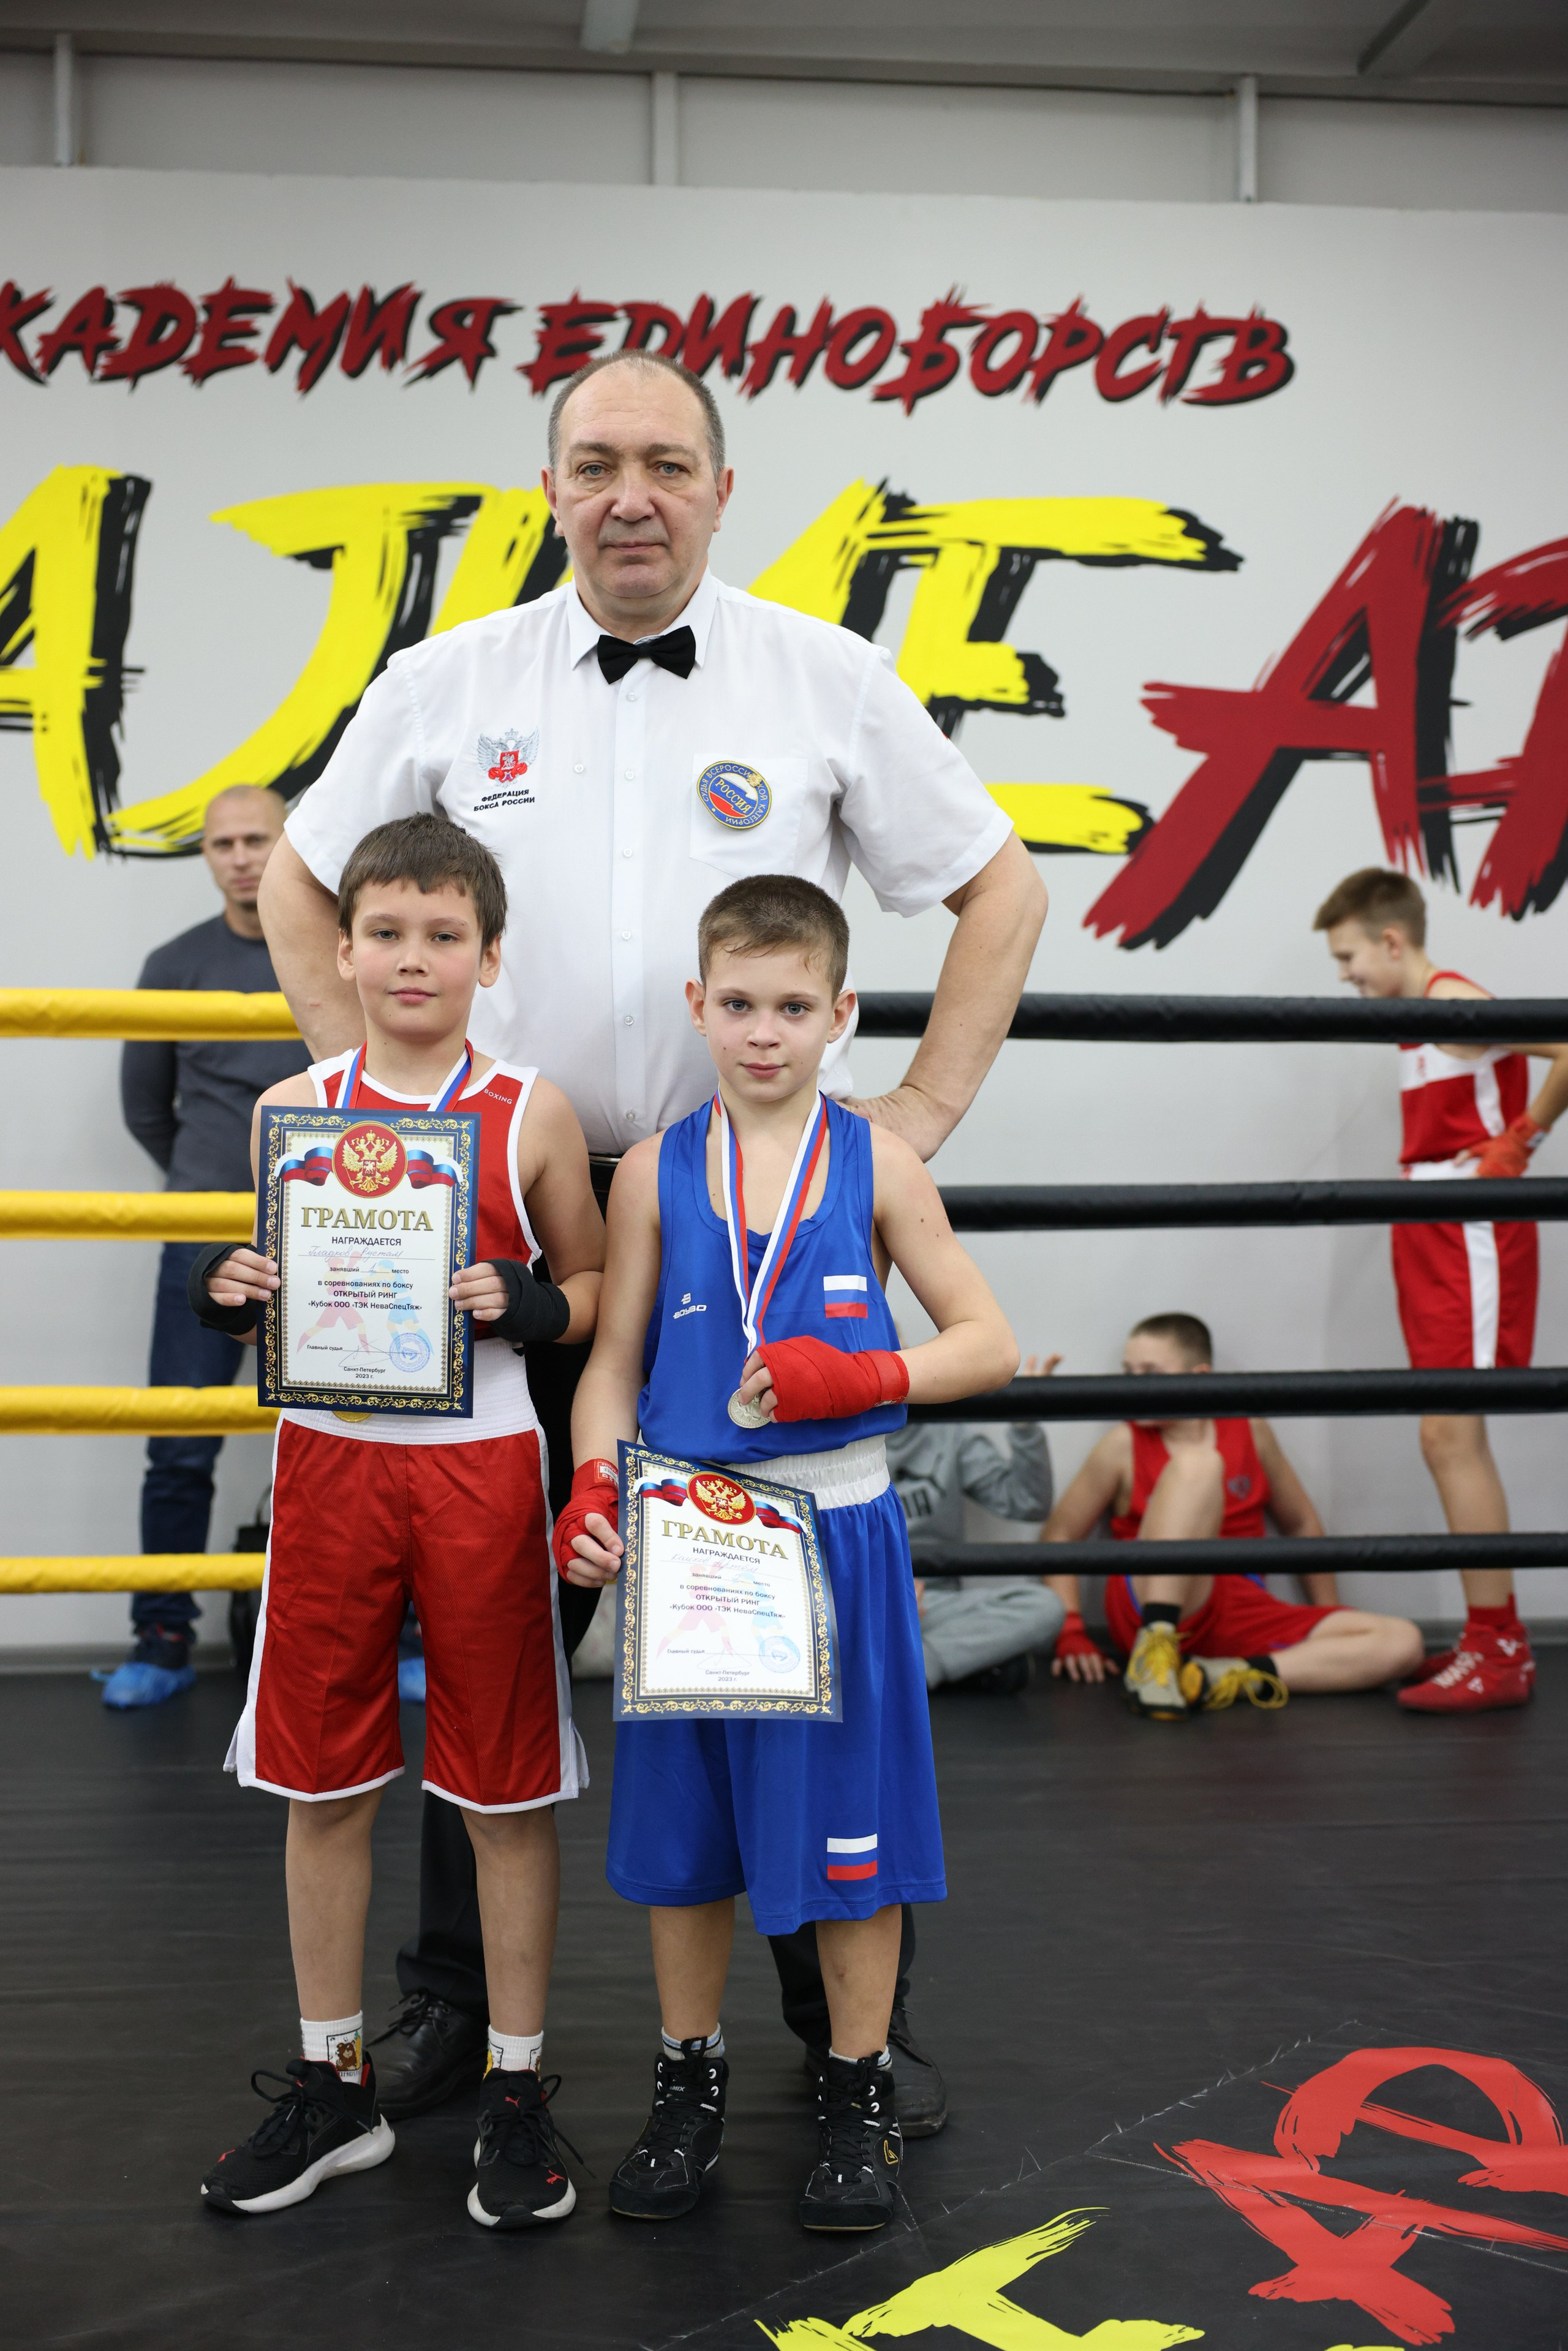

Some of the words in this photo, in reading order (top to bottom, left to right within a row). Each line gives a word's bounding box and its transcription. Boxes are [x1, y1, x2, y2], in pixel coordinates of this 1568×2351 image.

[516, 285, 1295, 417] ЕДИНОБОРСТВ
[700, 778, 709, 802] СУДЬЯ
[706, 764, 768, 801] ВСЕРОССИКОЙ
[481, 789, 529, 802] ФЕДЕРАЦИЯ
[715, 778, 752, 813] РОССИЯ
[473, 801, 499, 812] БОКСА
[502, 796, 535, 806] РОССИИ
[725, 804, 766, 825] КАТЕГОРИИ
[484, 1088, 513, 1104] BOXING
[301, 1207, 434, 1231] ГРАМОТА
[331, 1236, 402, 1246] НАГРАЖДАЕТСЯ
[333, 1289, 376, 1298] ОТКРЫТЫЙ
[393, 1281, 413, 1290] боксу
[673, 1304, 707, 1319] BOYBO
[662, 1519, 789, 1560] ГРАМОТА
[693, 1547, 761, 1564] НАГРАЖДАЕТСЯ
[686, 1584, 743, 1595] соревнованиях
[755, 1591, 775, 1600] боксу
[696, 1594, 739, 1604] ОТКРЫТЫЙ
